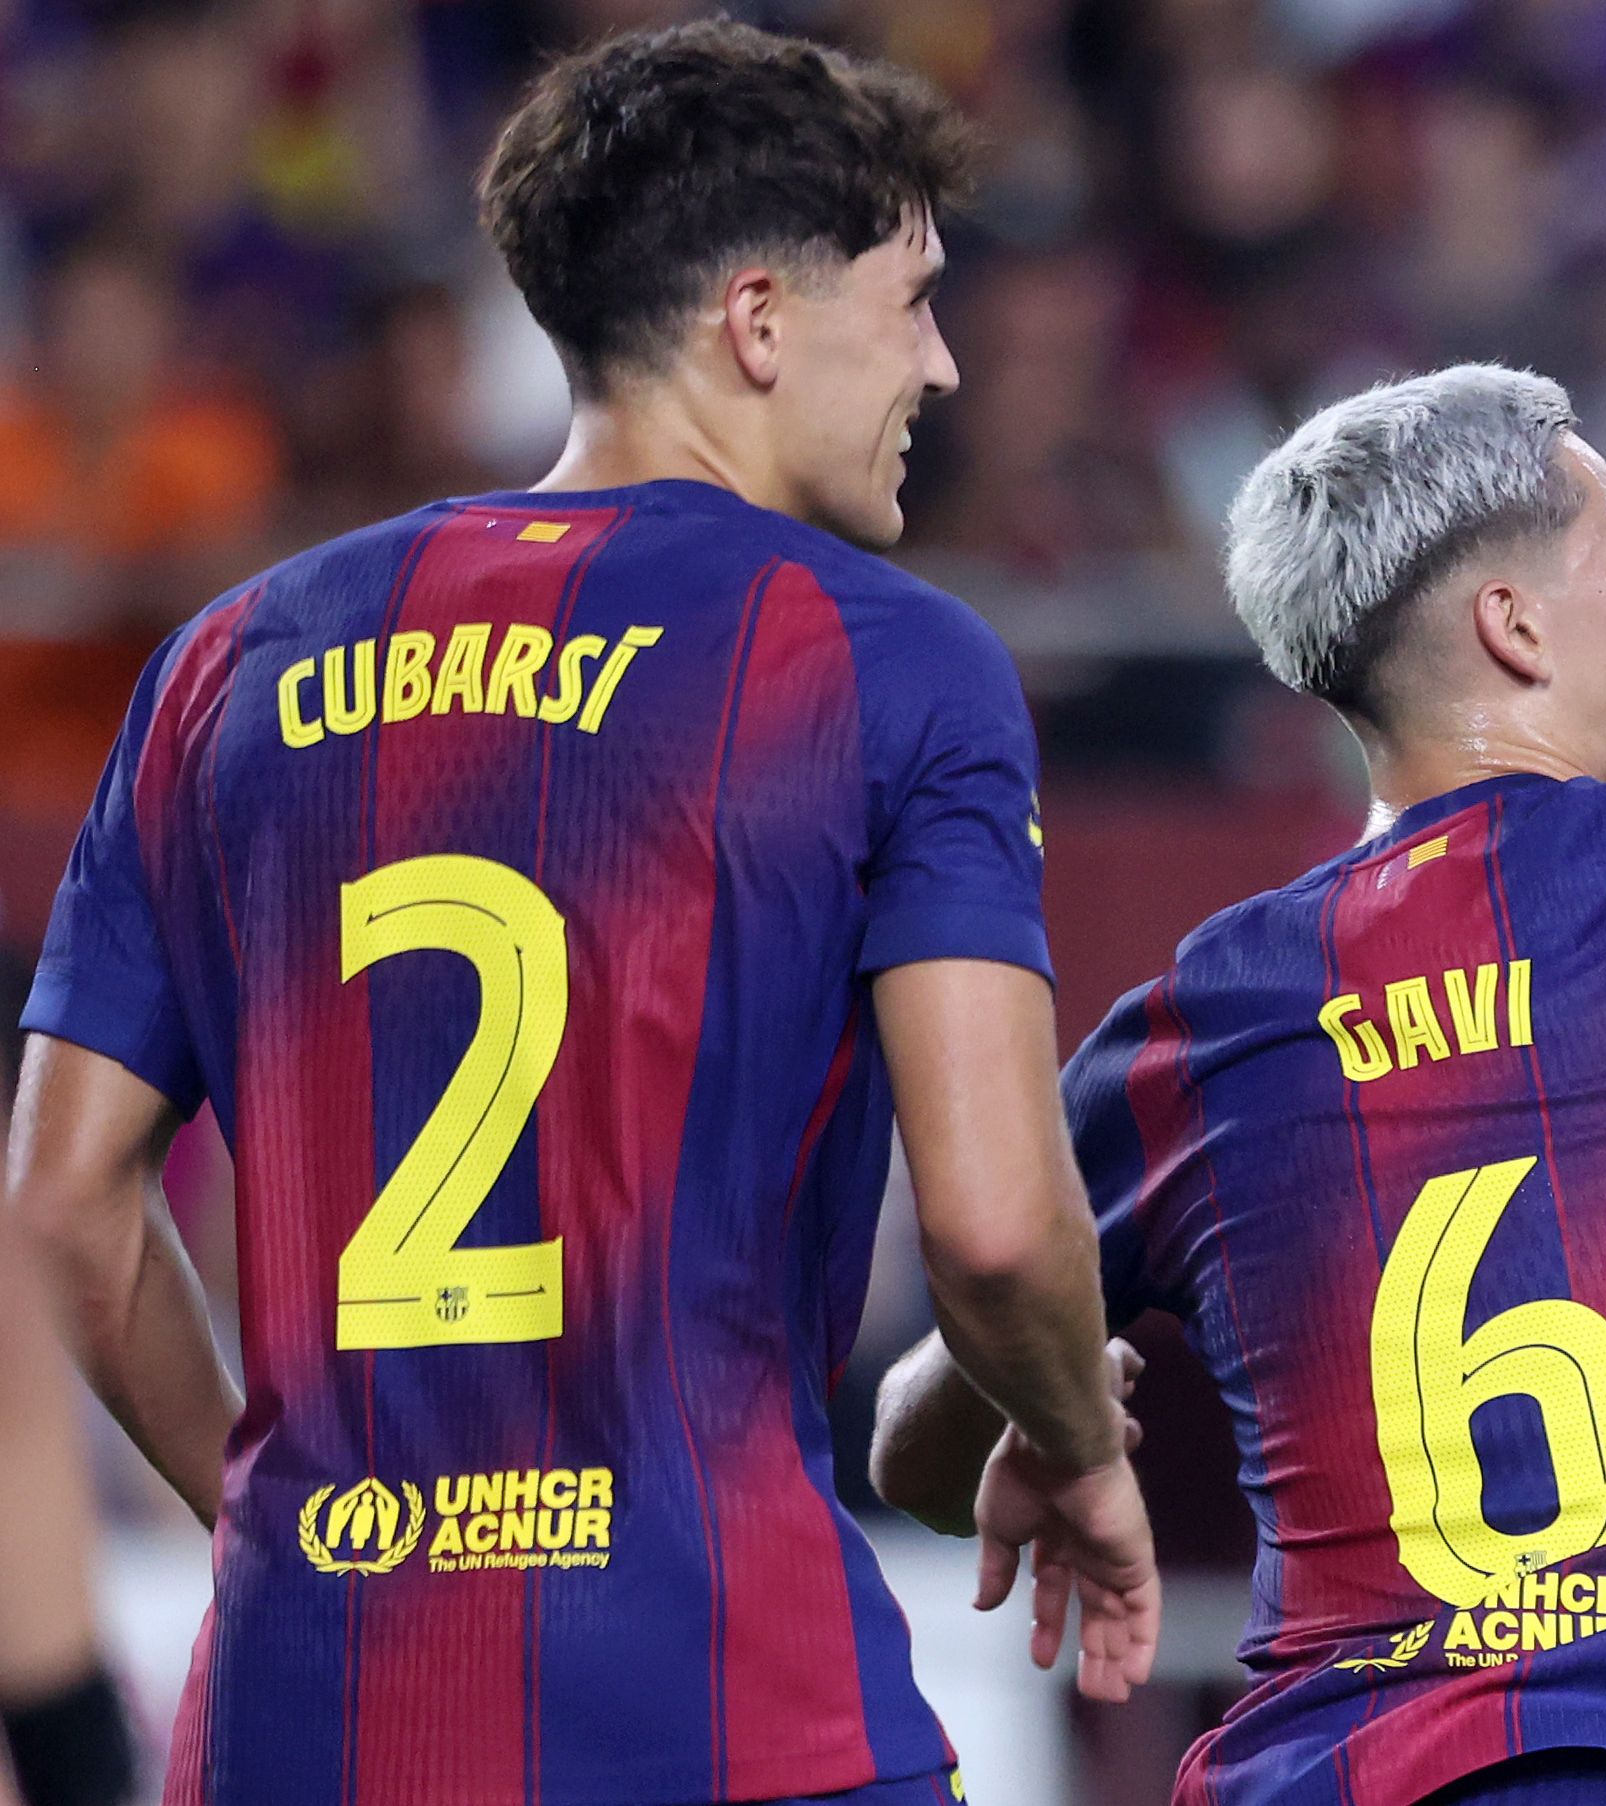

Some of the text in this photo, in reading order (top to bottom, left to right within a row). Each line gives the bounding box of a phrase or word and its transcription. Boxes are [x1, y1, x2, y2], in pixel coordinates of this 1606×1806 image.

[277, 622, 664, 749] CUBARSÍ
[1317, 958, 1534, 1082] GAVI
[337, 853, 569, 1350] 2
[434, 1468, 615, 1516] UNHCR
[428, 1508, 611, 1556] ACNUR
[429, 1550, 611, 1573] The UN Refugee Agency
[1445, 1652, 1476, 1668] The
[1478, 1653, 1503, 1668] UN
